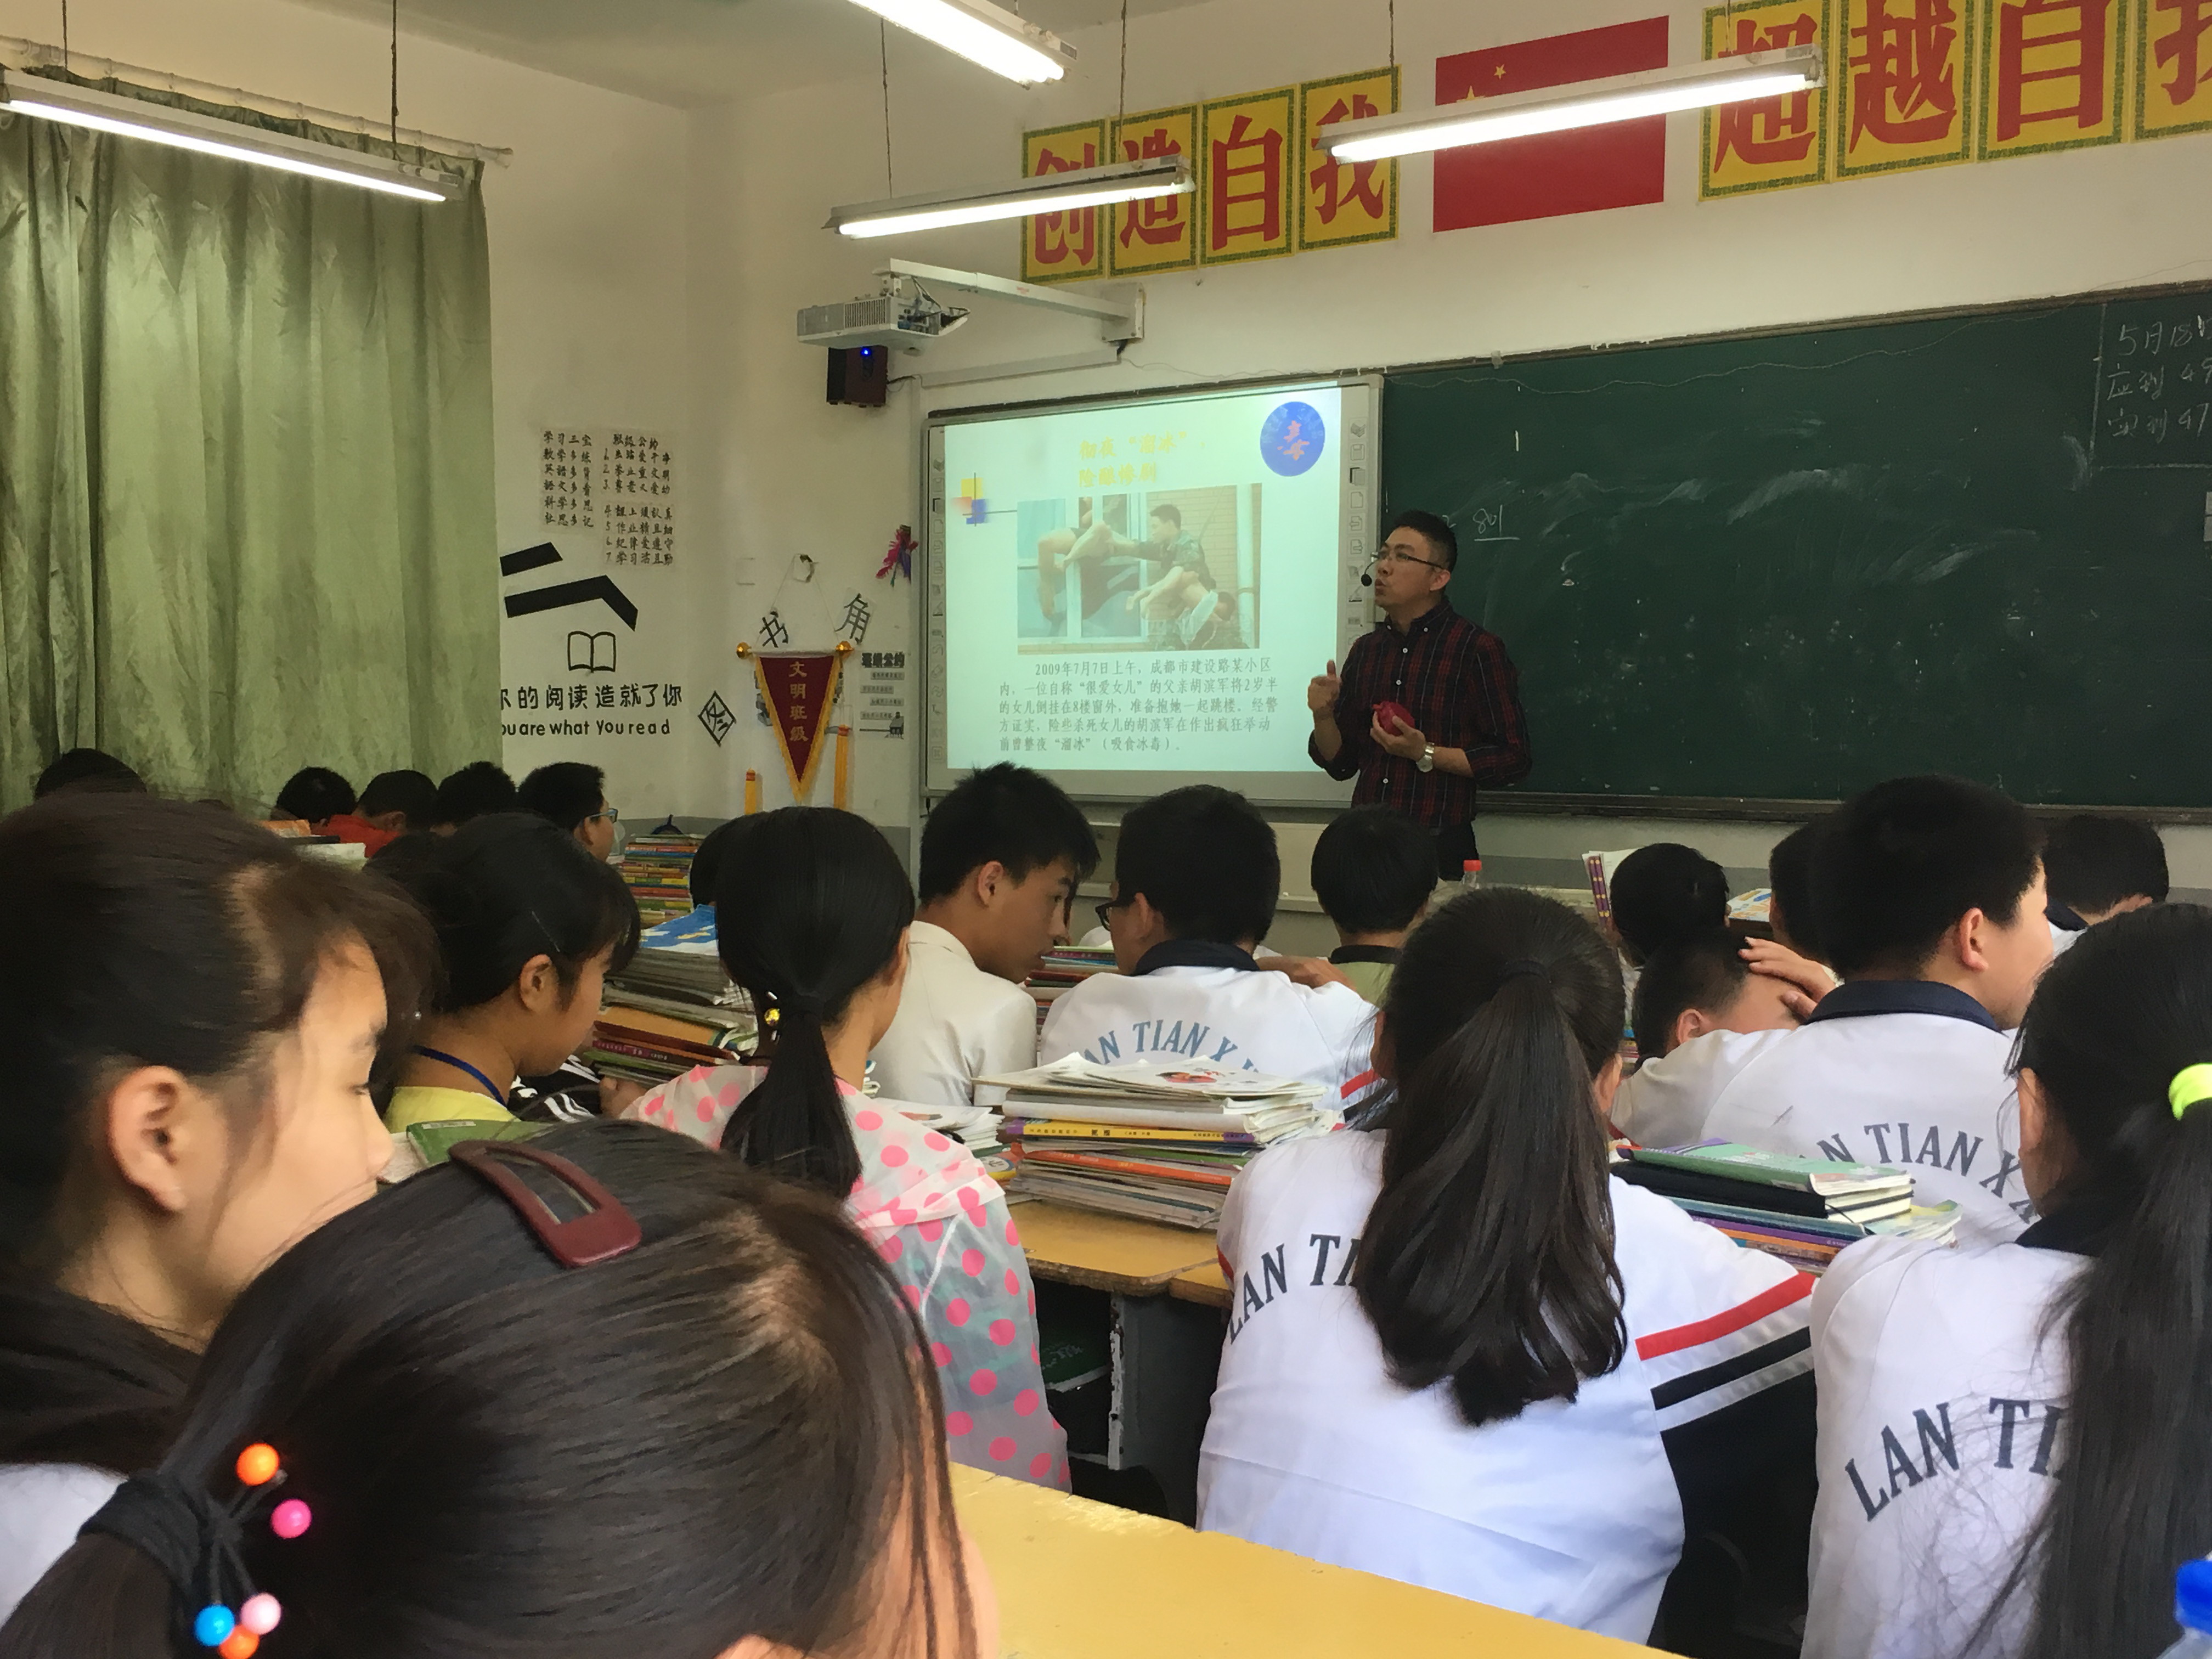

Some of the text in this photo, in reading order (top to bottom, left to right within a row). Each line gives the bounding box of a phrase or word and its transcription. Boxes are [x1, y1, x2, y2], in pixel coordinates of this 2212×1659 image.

[549, 719, 590, 736] what
[788, 661, 809, 742] 文明班级
[1132, 1019, 1211, 1058] TIAN
[1864, 1122, 1984, 1177] TIAN
[1309, 1233, 1362, 1286] TI
[1844, 1397, 2065, 1522] LAN TI
